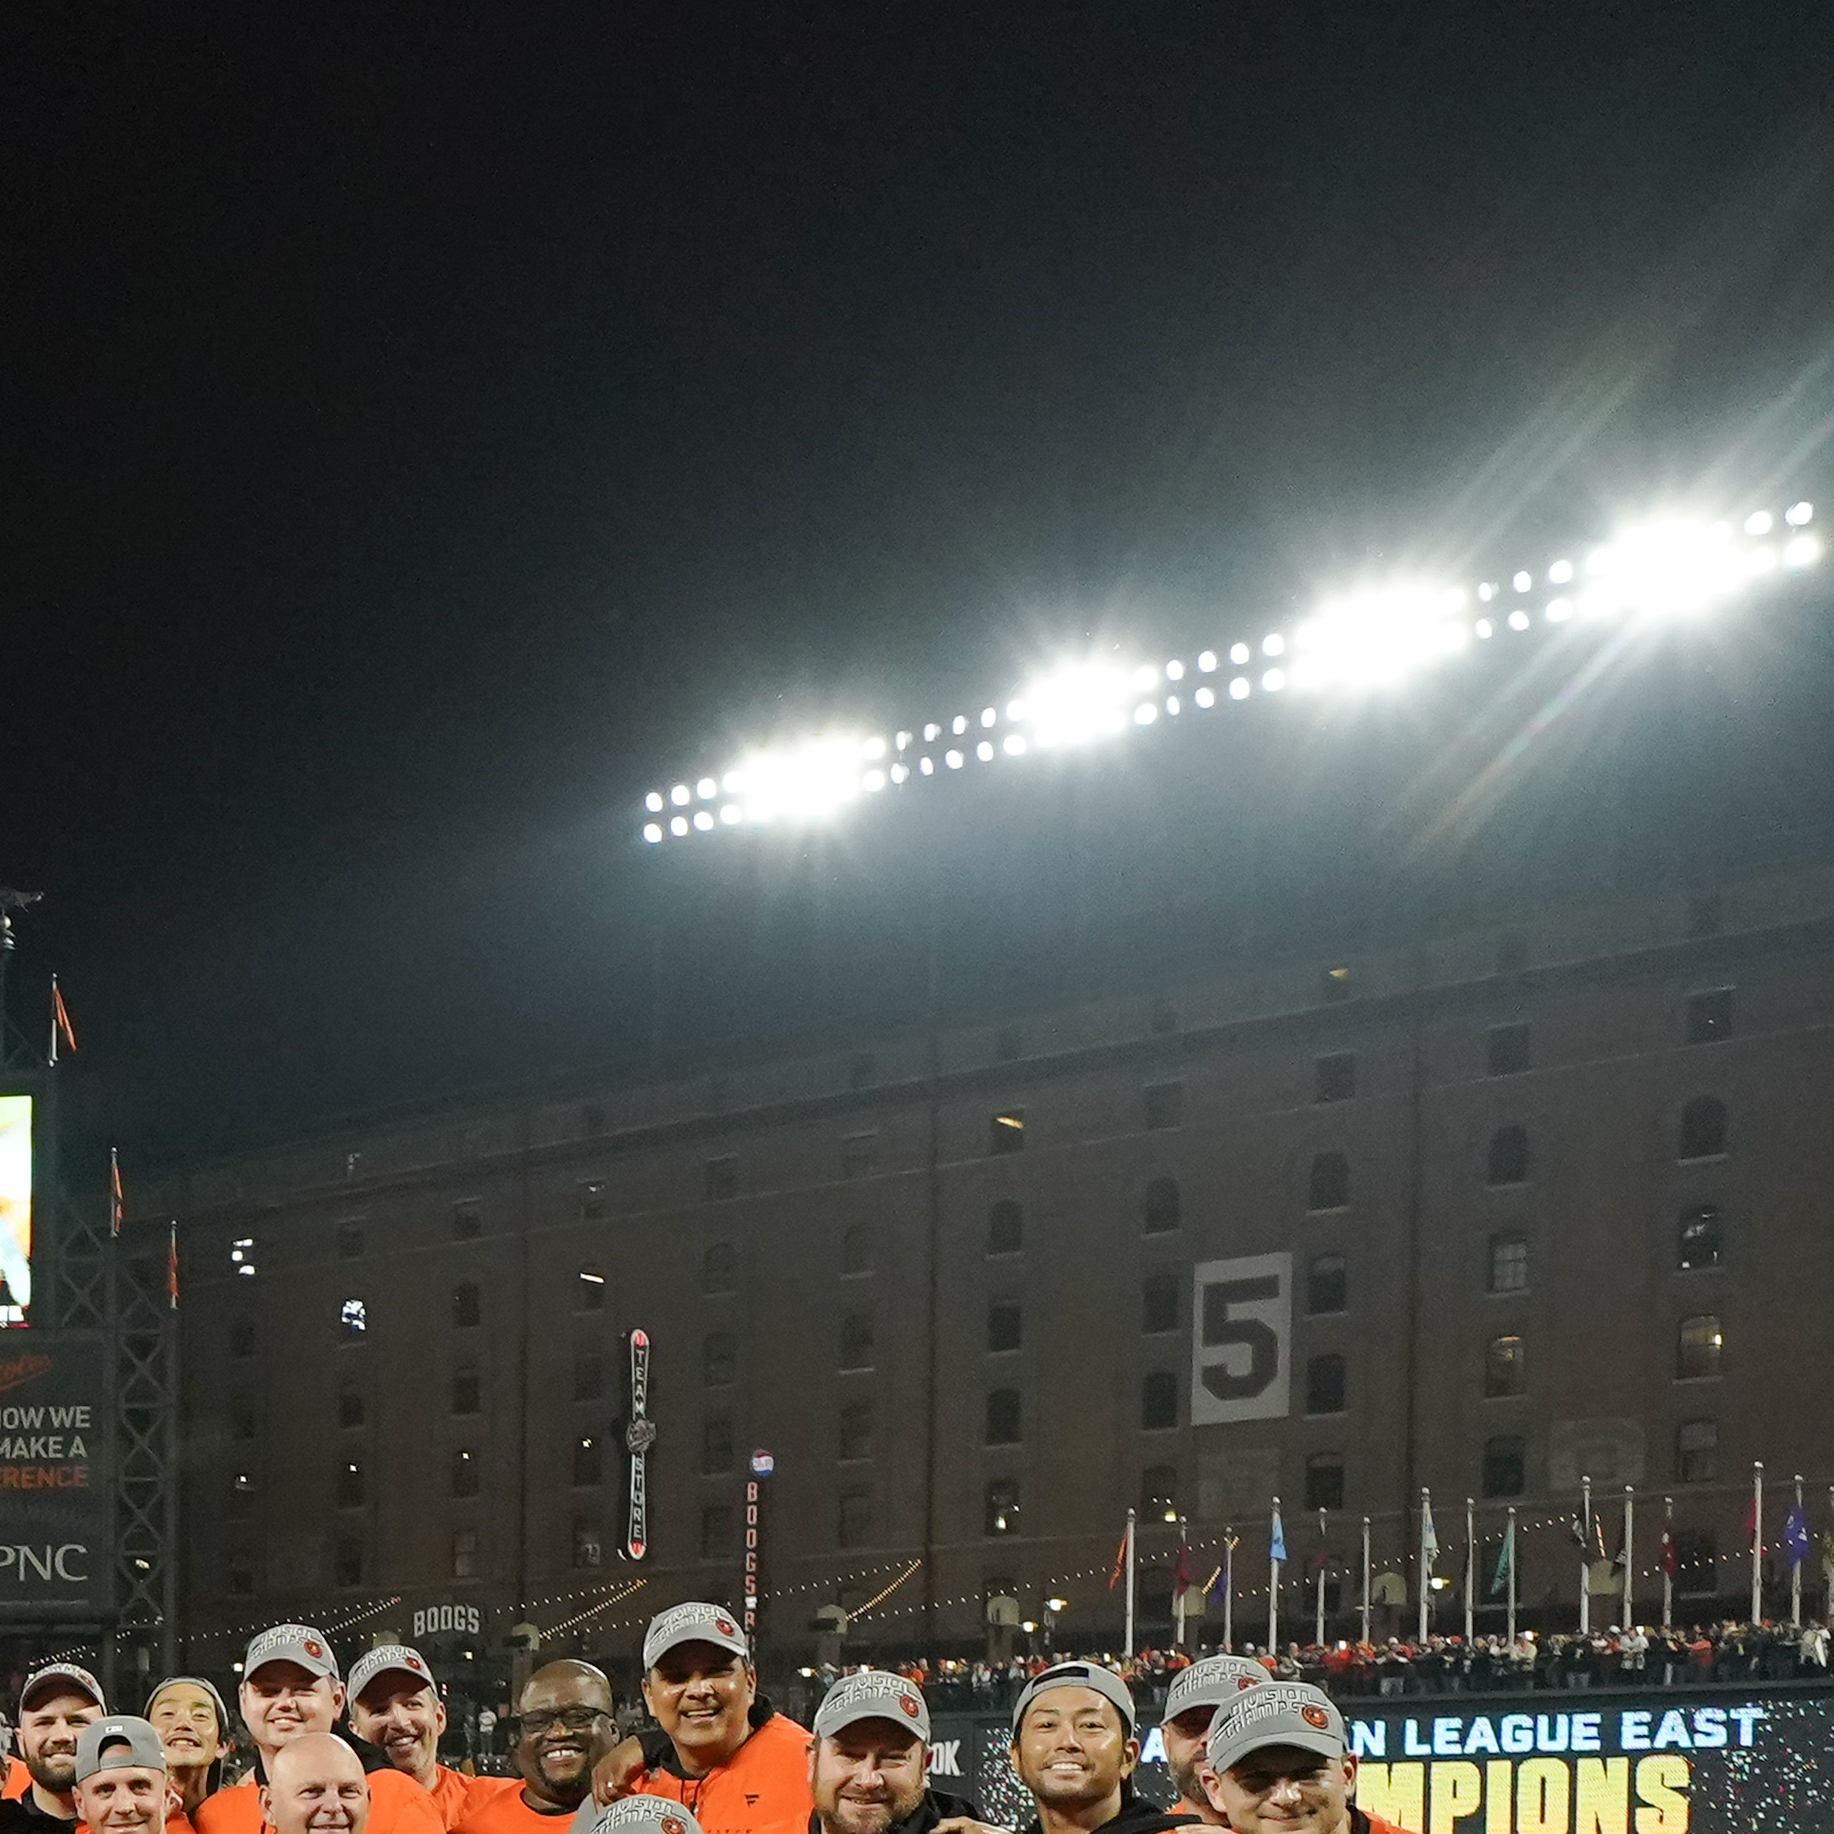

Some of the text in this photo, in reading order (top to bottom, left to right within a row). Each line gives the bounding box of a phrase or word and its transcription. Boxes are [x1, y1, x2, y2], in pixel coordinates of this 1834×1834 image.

[1201, 1273, 1281, 1401] 5
[635, 1349, 646, 1416] TEAM
[41, 1405, 92, 1429] WE
[68, 1436, 88, 1459] A
[633, 1456, 645, 1540] STORE
[1408, 1713, 1603, 1756] LEAGUE
[1621, 1707, 1765, 1749] EAST
